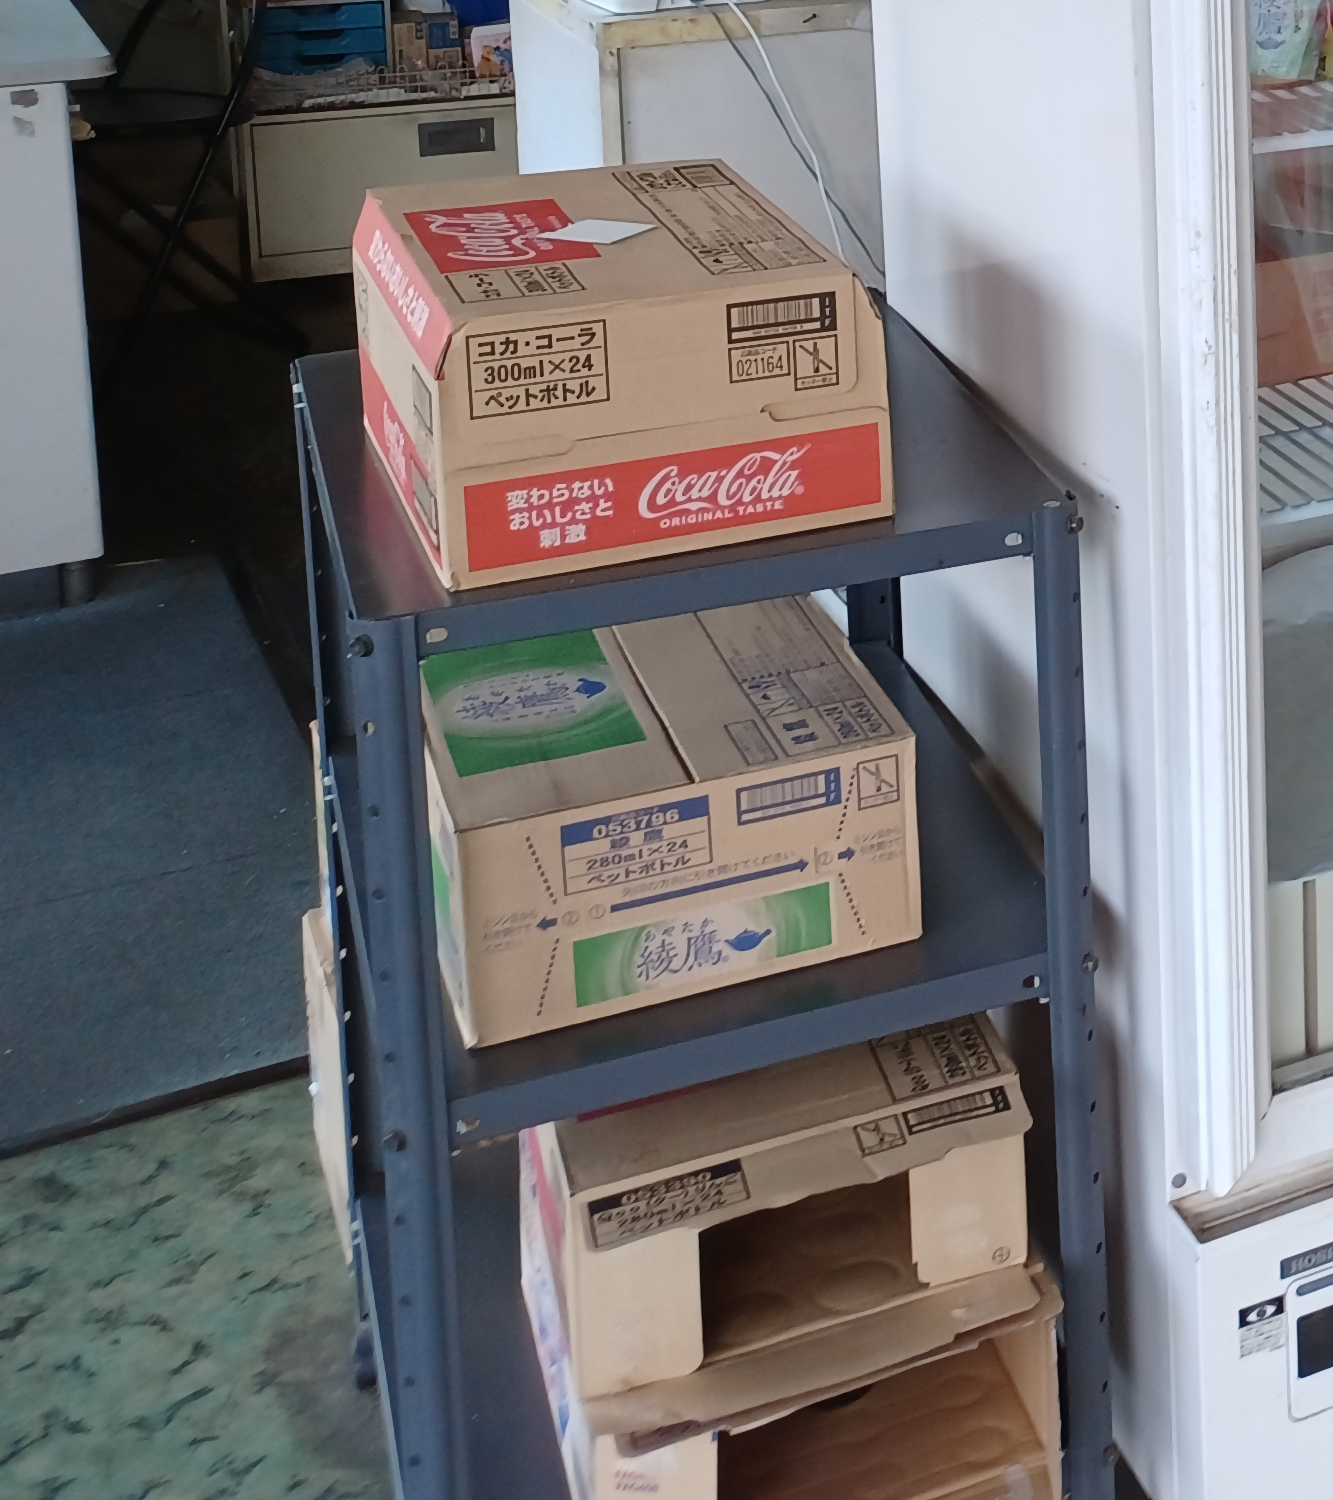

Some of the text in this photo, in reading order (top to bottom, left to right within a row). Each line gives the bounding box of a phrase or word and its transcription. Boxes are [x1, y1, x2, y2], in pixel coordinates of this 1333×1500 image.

[477, 328, 598, 360] コカ・コーラ
[736, 355, 784, 377] 021164
[484, 380, 597, 410] ペットボトル
[506, 476, 615, 508] 変わらない
[638, 443, 812, 518] Coca-Cola
[509, 500, 615, 531] おいしさと
[659, 499, 784, 529] ORIGINAL TASTE
[538, 523, 588, 549] 刺激
[592, 808, 680, 839] 053796
[587, 855, 692, 884] ペットボトル
[644, 917, 715, 943] あやたか
[636, 928, 724, 982] 綾鷹
